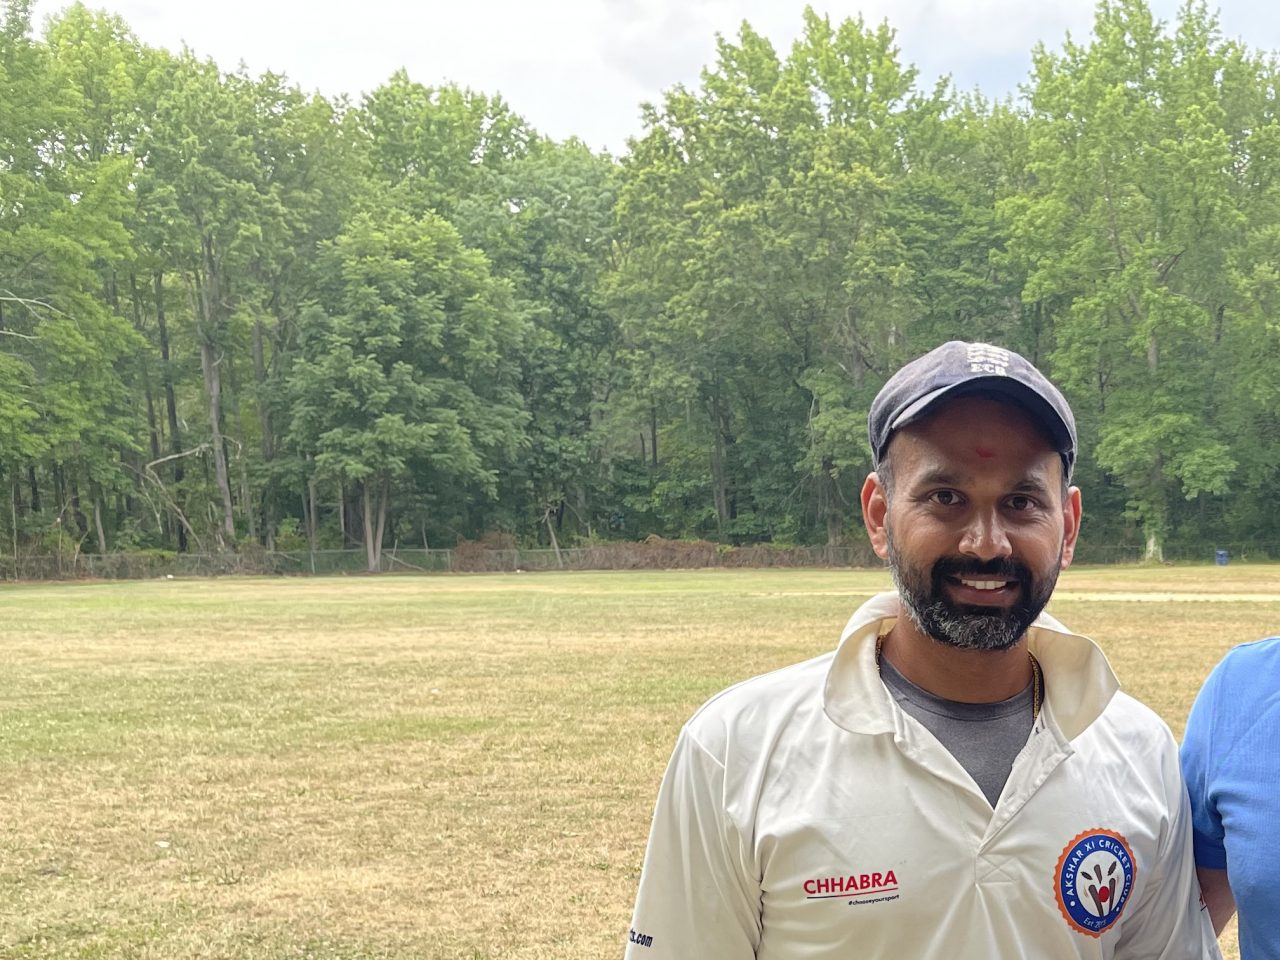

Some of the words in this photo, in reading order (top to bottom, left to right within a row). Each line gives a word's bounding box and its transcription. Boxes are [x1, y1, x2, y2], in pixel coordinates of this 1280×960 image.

[803, 870, 898, 894] CHHABRA
[1065, 849, 1084, 896] AKSHAR
[1084, 841, 1096, 852] XI
[1098, 839, 1131, 869] CRICKET
[1120, 874, 1132, 903] CLUB
